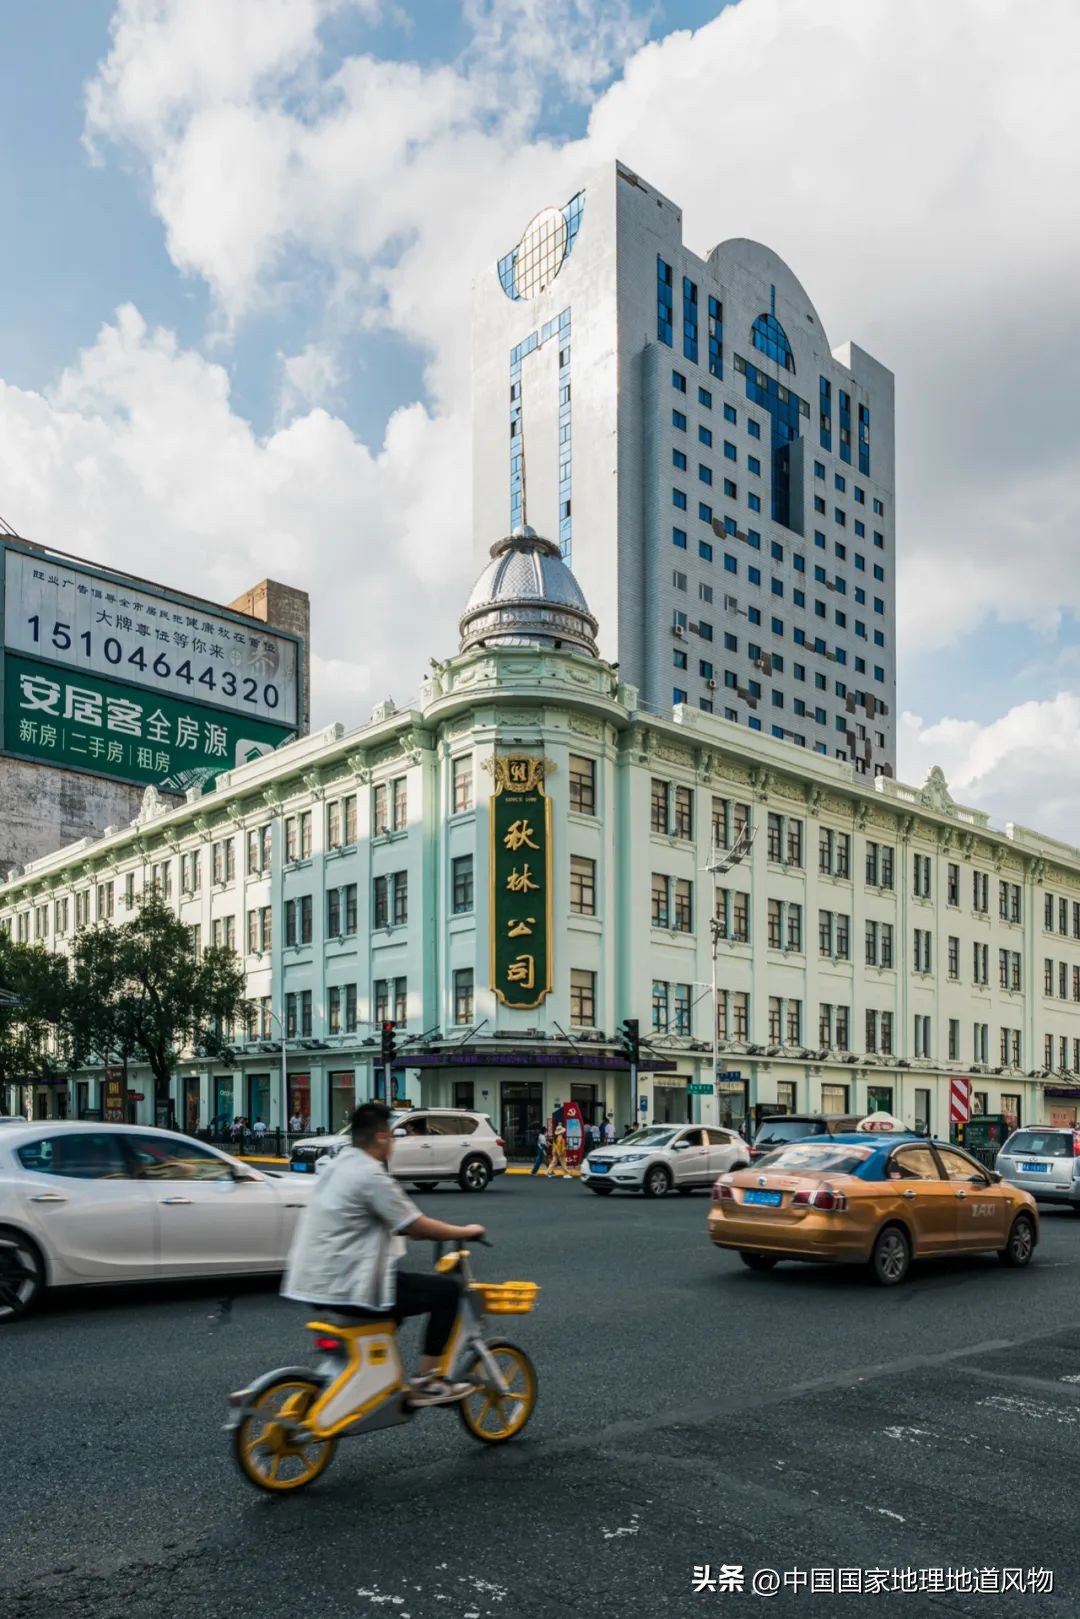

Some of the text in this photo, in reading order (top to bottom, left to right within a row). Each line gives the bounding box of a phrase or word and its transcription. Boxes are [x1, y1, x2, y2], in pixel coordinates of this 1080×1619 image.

[27, 615, 279, 709] 15104644320
[19, 718, 171, 774] 新房 二手房 租房
[503, 819, 540, 991] 秋林公司
